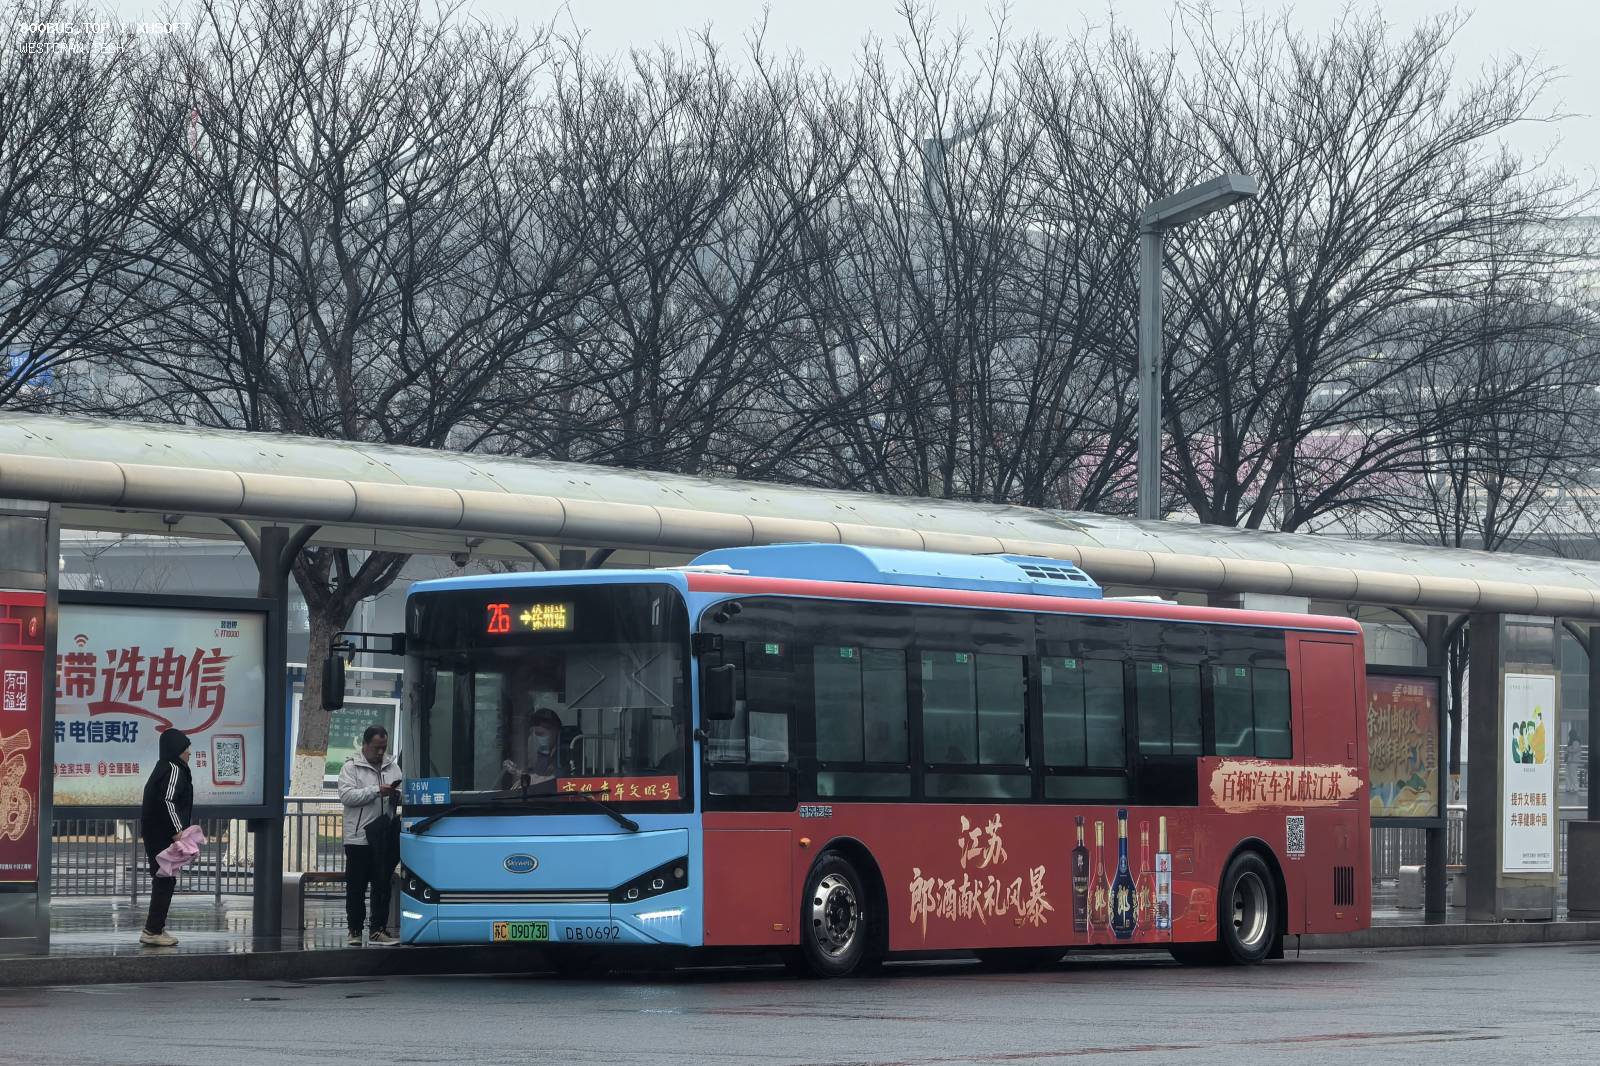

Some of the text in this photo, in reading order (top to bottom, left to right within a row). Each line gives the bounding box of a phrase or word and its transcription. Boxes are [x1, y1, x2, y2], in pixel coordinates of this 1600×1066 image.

[487, 603, 510, 633] 26
[70, 720, 138, 743] 电信更好
[411, 781, 429, 791] 26W
[1222, 770, 1342, 802] 百辆汽车礼献江苏
[1511, 792, 1548, 807] 提升文明素质
[1511, 813, 1548, 827] 共享健康中国
[958, 813, 1008, 869] 江苏
[909, 865, 1055, 943] 郎酒献礼风暴
[566, 926, 621, 940] DB0692
